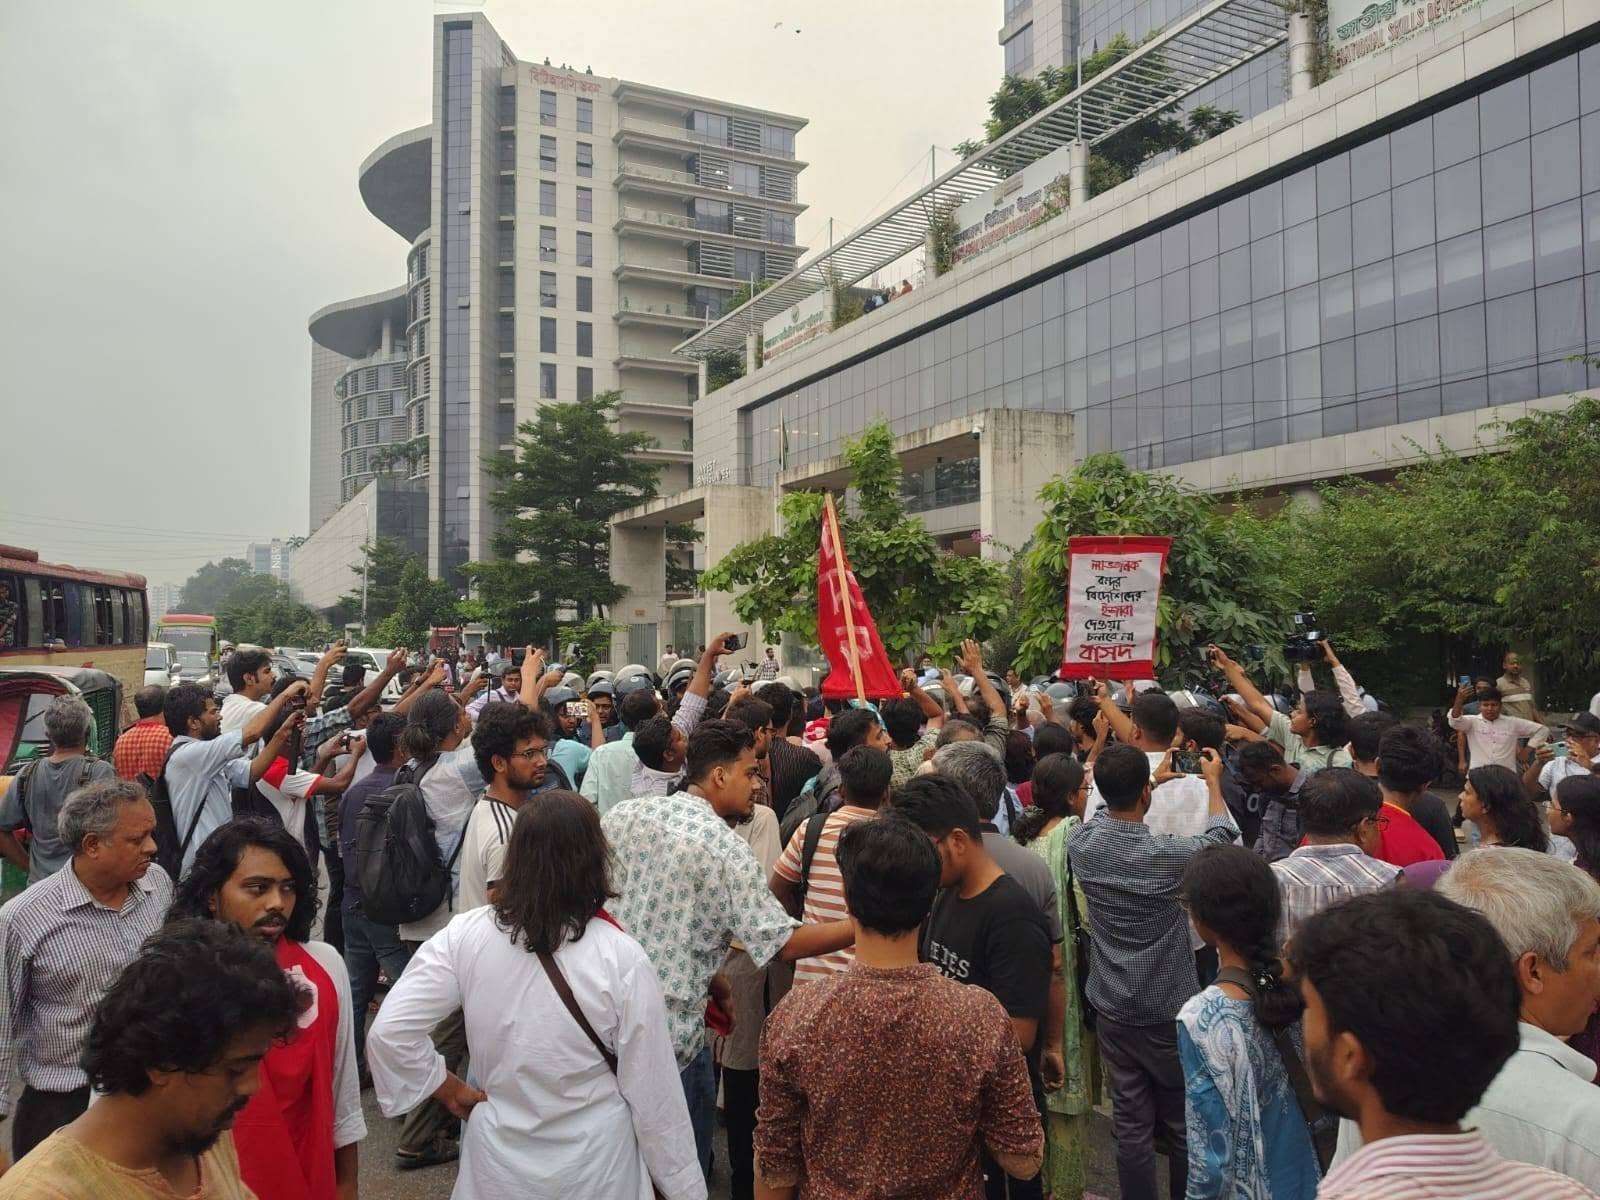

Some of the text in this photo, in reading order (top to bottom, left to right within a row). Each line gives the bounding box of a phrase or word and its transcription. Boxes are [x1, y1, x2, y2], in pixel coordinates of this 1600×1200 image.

[1388, 8, 1425, 41] SKILLS
[1085, 619, 1125, 631] দেওয়া
[1087, 632, 1117, 642] চলবে
[1078, 643, 1136, 662] বাসদ
